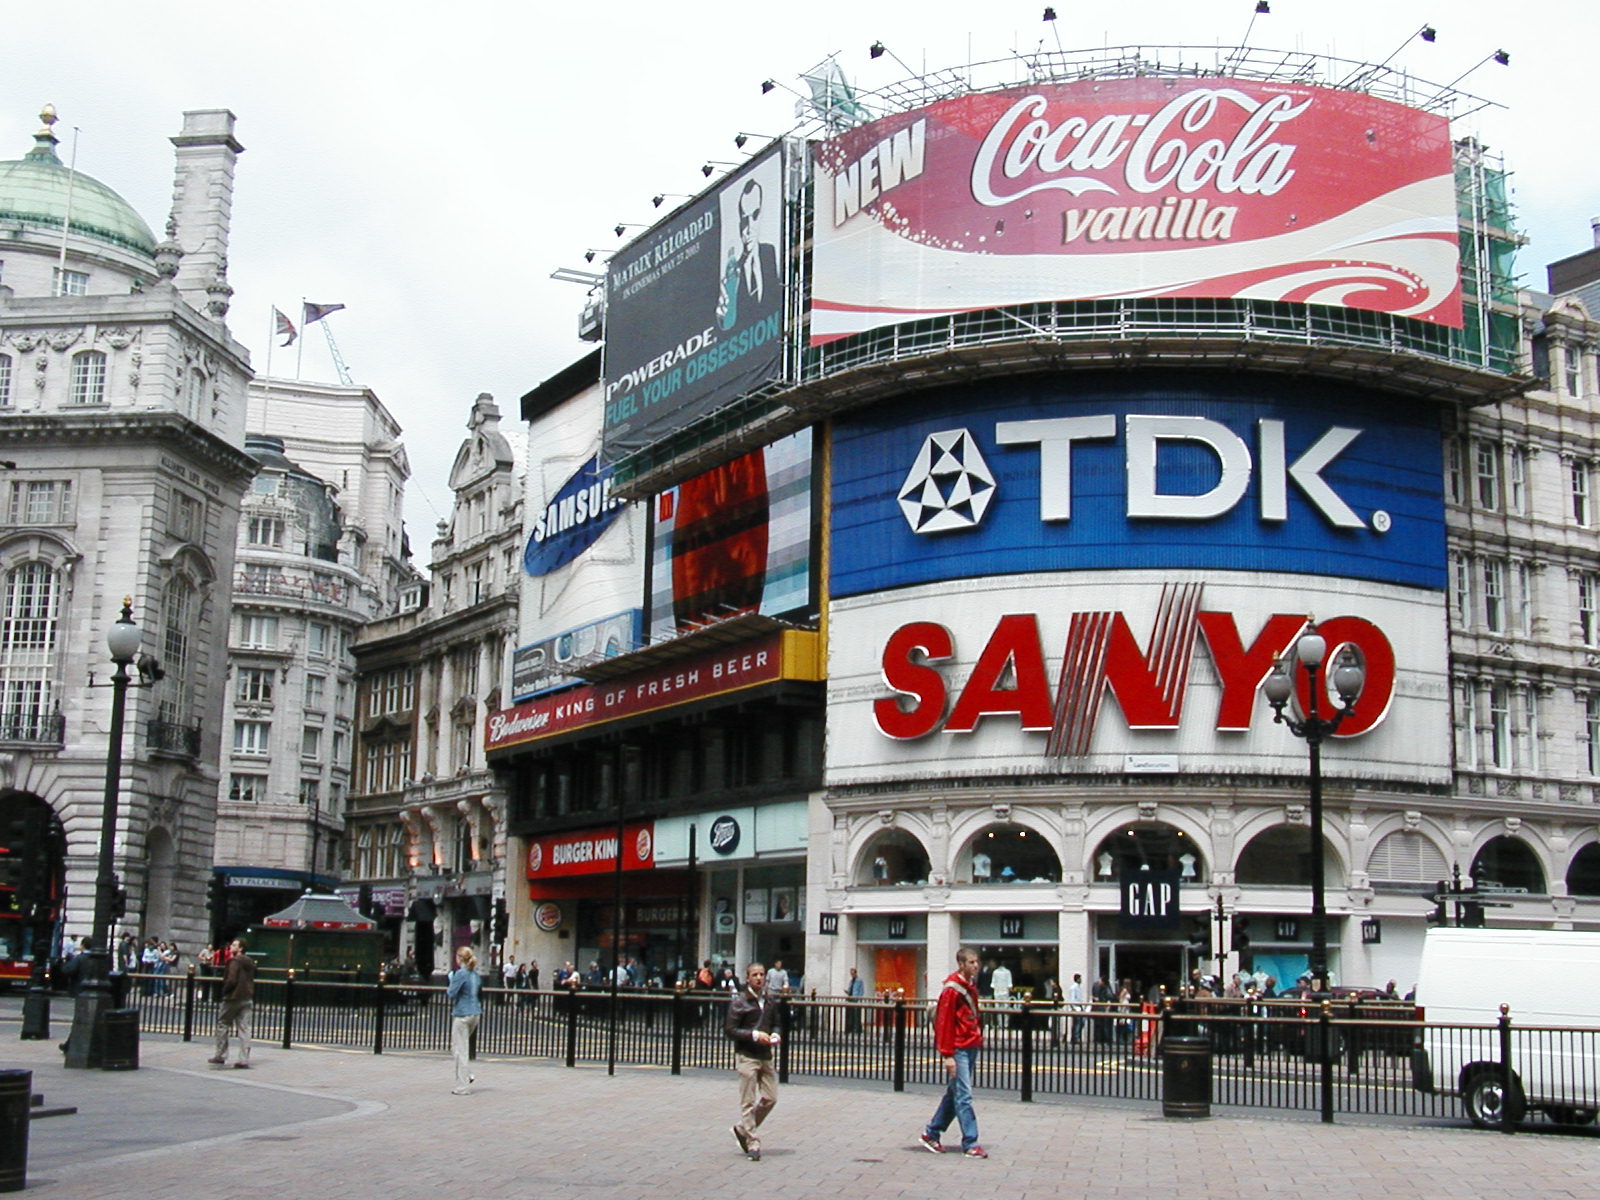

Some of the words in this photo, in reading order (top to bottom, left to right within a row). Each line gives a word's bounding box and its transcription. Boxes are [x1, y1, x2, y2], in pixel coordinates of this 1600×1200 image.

[833, 118, 928, 228] NEW
[970, 88, 1312, 206] Coca-Cola
[1063, 197, 1238, 244] vanilla
[612, 251, 652, 291] MATRIX
[653, 211, 713, 267] RELOADED
[605, 394, 638, 429] FUEL
[642, 368, 682, 408] YOUR
[685, 311, 780, 384] OBSESSION
[995, 414, 1370, 529] TDK
[534, 477, 627, 543] SAMSUN
[489, 709, 550, 742] Budweiser
[555, 698, 595, 719] KING
[605, 689, 626, 707] OF
[637, 670, 699, 699] FRESH
[712, 651, 768, 679] BEER
[873, 582, 1396, 759] SANYO
[553, 841, 593, 865] BURGER
[594, 838, 618, 861] KIN
[822, 915, 837, 931] GAP
[890, 918, 906, 935] GAP
[1002, 919, 1020, 934] GAP
[1129, 882, 1172, 916] GAP
[1278, 920, 1296, 936] GAP
[1363, 924, 1378, 940] GAP
